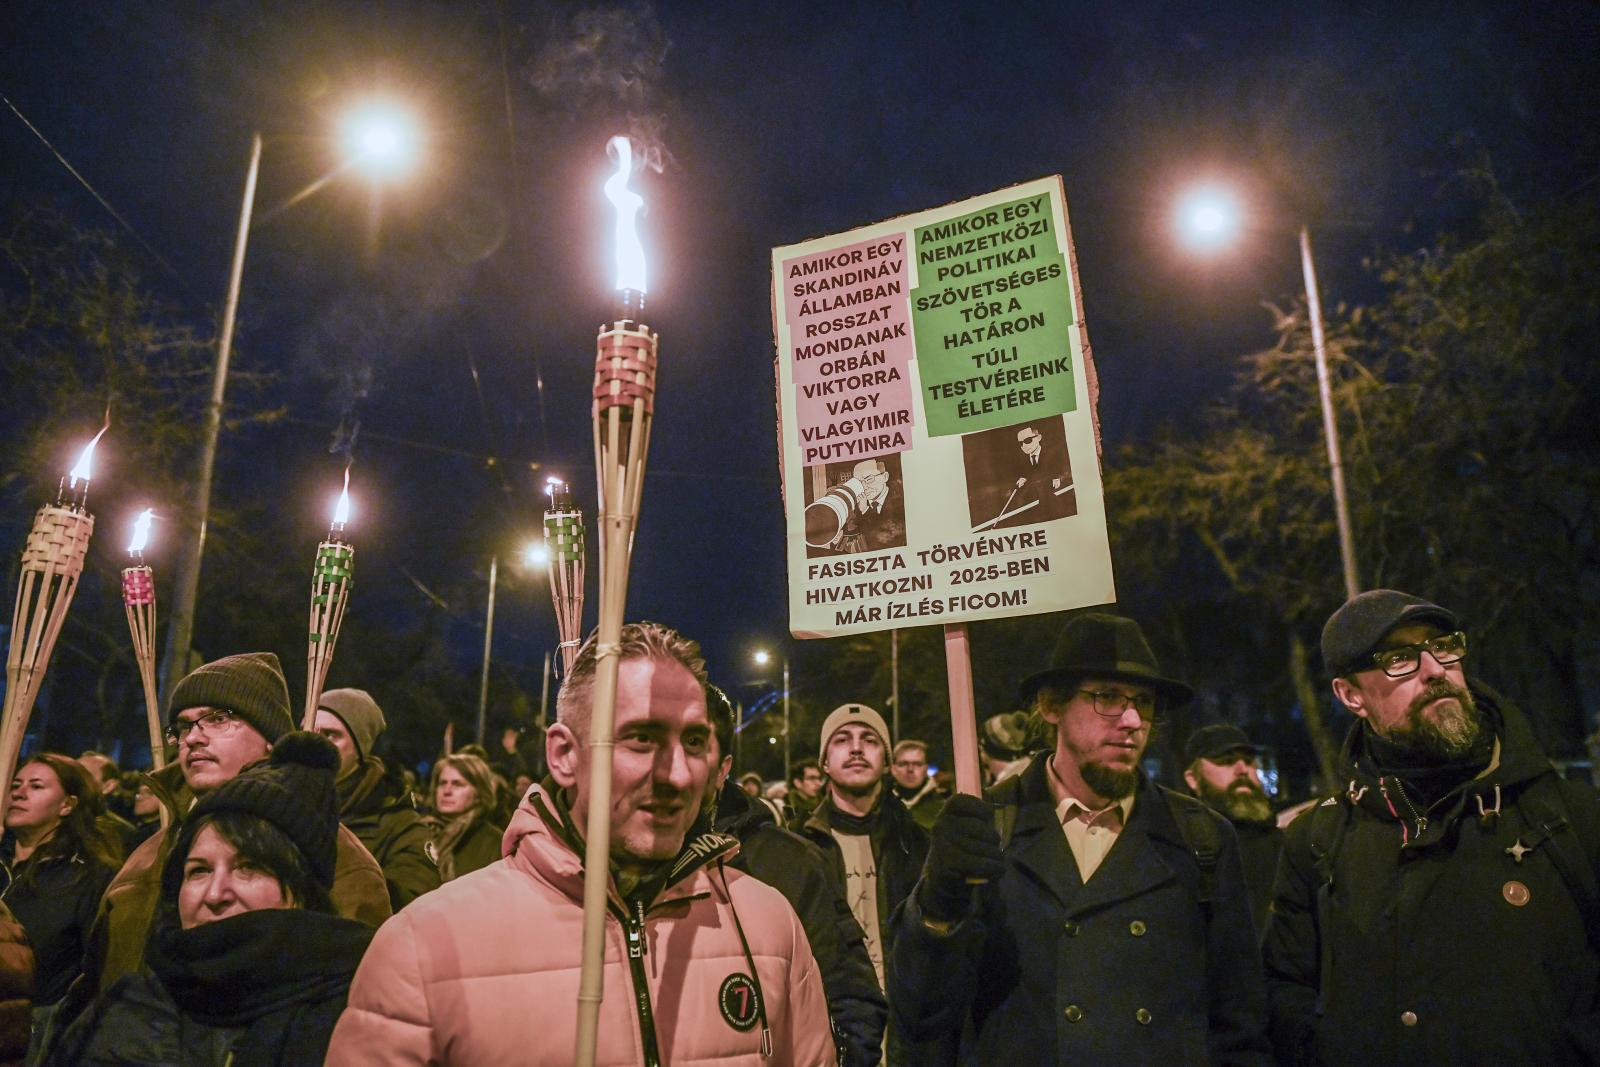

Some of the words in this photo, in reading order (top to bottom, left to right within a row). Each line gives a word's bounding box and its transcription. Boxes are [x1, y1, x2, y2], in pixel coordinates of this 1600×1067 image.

[921, 212, 999, 244] AMIKOR
[1003, 198, 1042, 222] EGY
[790, 250, 862, 278] AMIKOR
[867, 239, 903, 260] EGY
[921, 219, 1048, 264] NEMZETKÖZI
[794, 260, 902, 296] SKANDINÁV
[938, 245, 1035, 281] POLITIKAI
[799, 281, 900, 316] ÁLLAMBAN
[917, 264, 1061, 311] SZÖVETSÉGES
[806, 305, 891, 338] ROSSZAT
[960, 302, 1002, 322] TÖR
[1008, 298, 1022, 312] A
[796, 323, 906, 360] MONDANAK
[944, 312, 1044, 349] HATÁRON
[820, 350, 885, 376] ORBÁN
[972, 346, 1017, 368] TÚLI
[803, 368, 901, 398] VIKTORRA
[928, 357, 1069, 400] TESTVÉREINK
[826, 393, 880, 415] VAGY
[958, 386, 1045, 418] ÉLETÉRE
[802, 410, 910, 442] VLAGYIMIR
[807, 432, 905, 462] PUTYINRA
[809, 554, 906, 580] FASISZTA
[917, 530, 1047, 566] TÖRVÉNYRE
[806, 574, 932, 605] HIVATKOZNI
[950, 556, 1049, 585] 2025-BEN
[836, 605, 881, 625] MÁR
[887, 598, 944, 619] ÍZLÉS
[949, 589, 1027, 612] FICOM!
